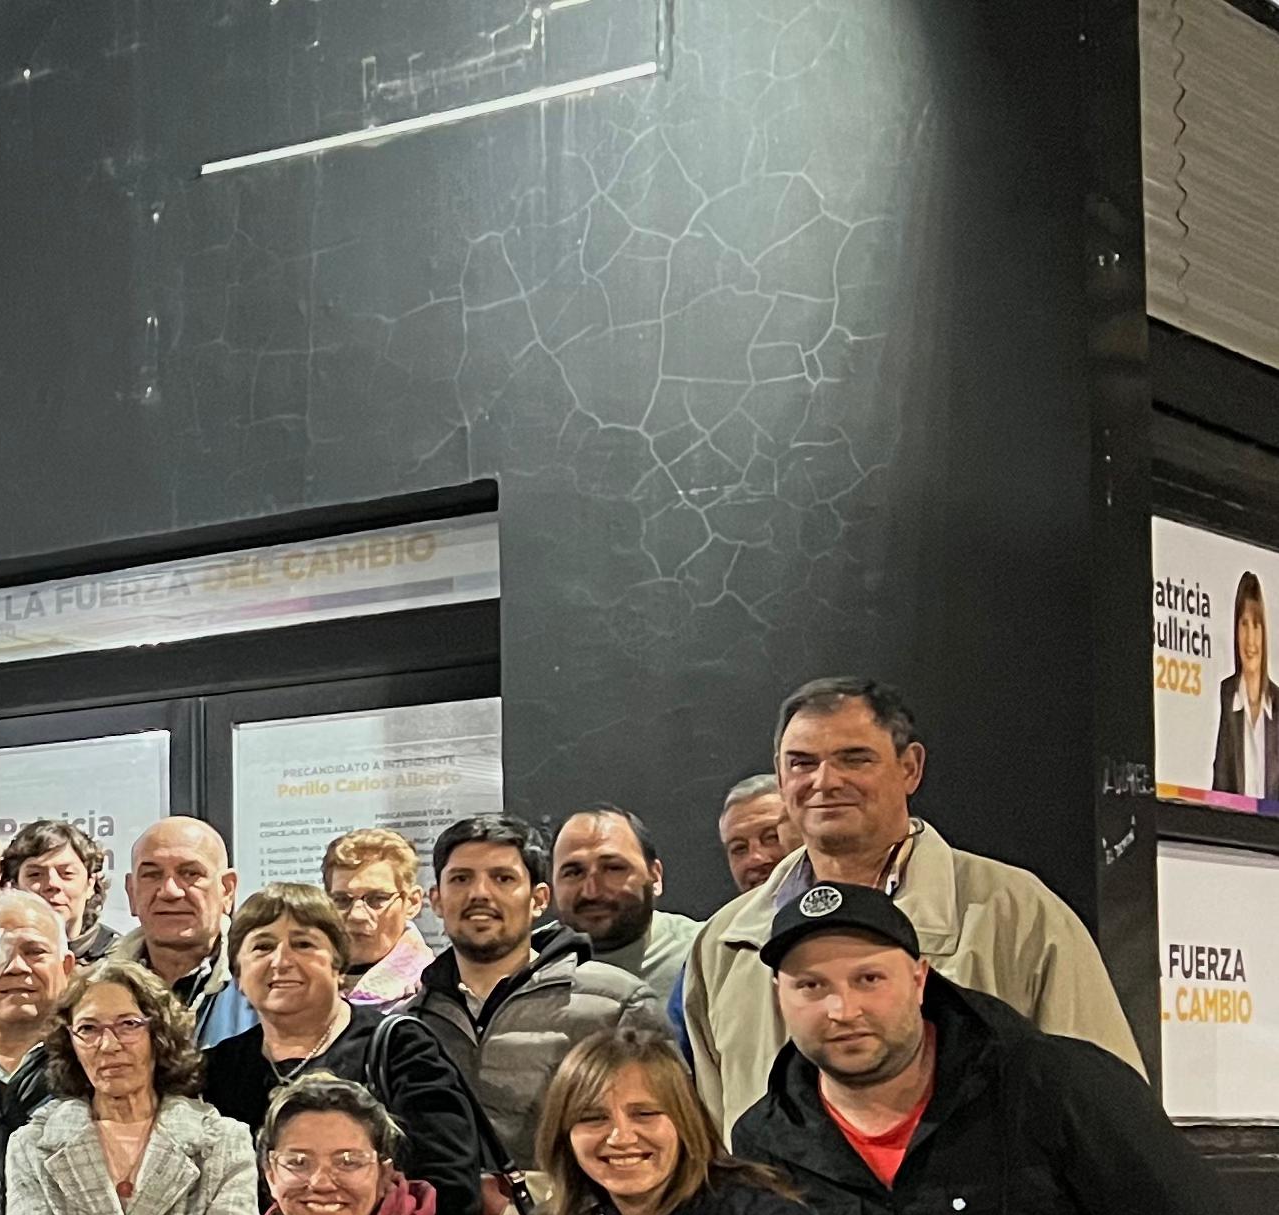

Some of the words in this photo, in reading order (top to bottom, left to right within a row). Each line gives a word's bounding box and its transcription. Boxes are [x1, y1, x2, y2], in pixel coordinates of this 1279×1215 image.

[5, 591, 46, 623] LA
[55, 570, 192, 615] FUERZA
[201, 554, 272, 592] DEL
[281, 533, 437, 581] CAMBIO
[1155, 577, 1211, 618] atricia
[1153, 615, 1211, 658] ullrich
[1156, 656, 1202, 696] 2023
[277, 781, 330, 798] Perillo
[1169, 944, 1247, 982] FUERZA
[1176, 986, 1253, 1024] CAMBIO
